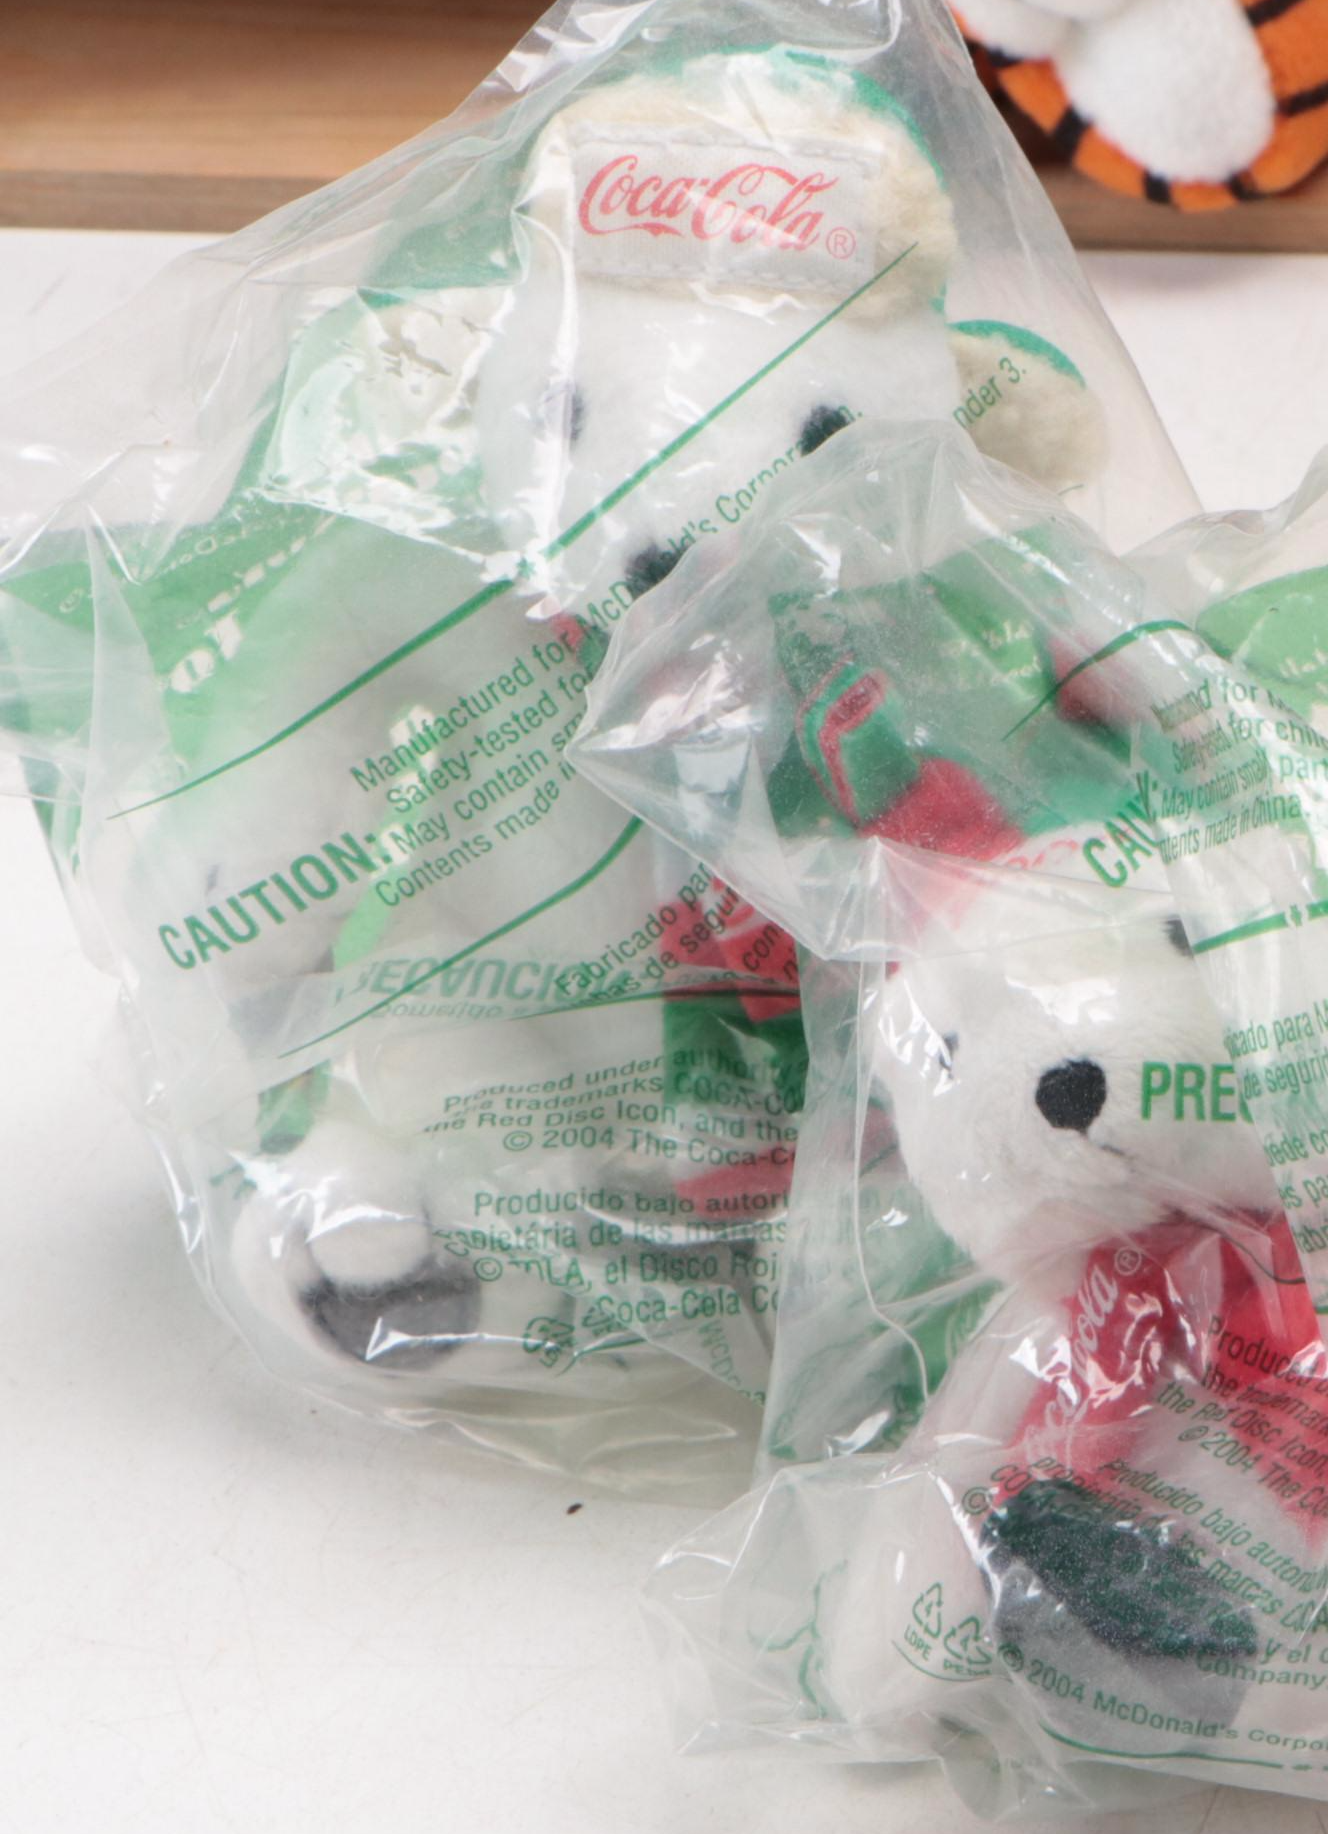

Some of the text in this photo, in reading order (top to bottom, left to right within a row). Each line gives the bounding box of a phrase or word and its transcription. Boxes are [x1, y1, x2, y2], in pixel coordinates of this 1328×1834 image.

[578, 154, 839, 251] Coca-Cola
[1218, 675, 1259, 704] for
[350, 656, 534, 792] Manufactured
[532, 631, 577, 672] for
[1227, 710, 1265, 740] for
[386, 689, 560, 813] Safety-tested
[1161, 785, 1194, 822] May
[375, 778, 560, 907] Contents made
[1203, 811, 1238, 850] made
[158, 749, 549, 970] CAUTION: May contain
[554, 905, 678, 997] Fabricado
[645, 951, 680, 981] de
[1273, 1012, 1315, 1051] para
[443, 1055, 666, 1113] Produced under
[504, 1076, 665, 1112] trademarks
[477, 1110, 535, 1129] Red
[545, 1106, 607, 1129] Disc
[616, 1101, 686, 1132] Icon,
[694, 1112, 746, 1140] and
[756, 1119, 799, 1143] the
[543, 1127, 679, 1160] 2004 The
[474, 1188, 696, 1217] Producido bajo
[588, 1221, 624, 1246] de
[605, 1255, 628, 1285] el
[640, 1253, 718, 1282] Disco
[597, 1286, 742, 1325] Coca-Cola
[1207, 1314, 1319, 1389] Produced
[1200, 1361, 1239, 1399] the
[1155, 1381, 1196, 1414] the
[1230, 1403, 1284, 1445] Disc
[1200, 1432, 1300, 1500] 2004 The
[1100, 1456, 1205, 1518] Producido
[1201, 1508, 1253, 1549] bajo
[1204, 1556, 1287, 1616] marcas
[1262, 1638, 1284, 1666] y
[1286, 1639, 1313, 1665] el
[1026, 1657, 1087, 1704] 2004
[1094, 1689, 1239, 1741] McDonald's
